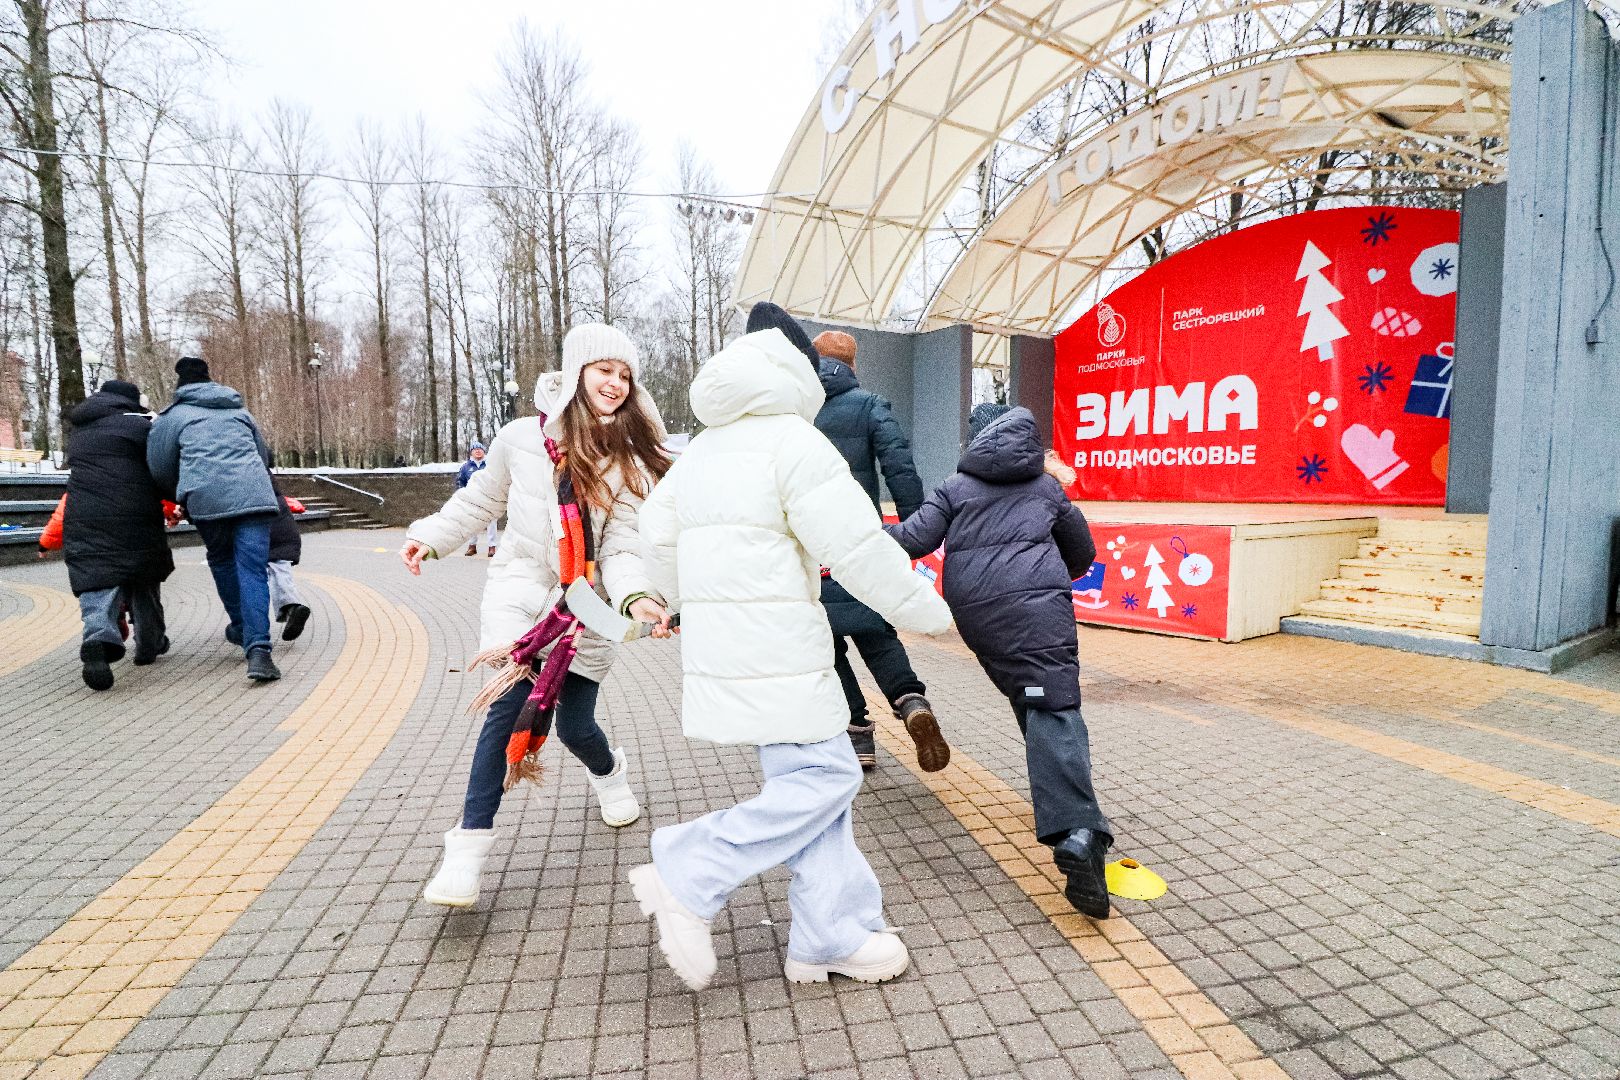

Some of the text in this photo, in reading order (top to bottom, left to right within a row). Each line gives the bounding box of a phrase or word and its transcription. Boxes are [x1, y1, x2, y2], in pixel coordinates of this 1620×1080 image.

[821, 65, 860, 134] С
[1047, 59, 1292, 207] ГОДОМ!
[1172, 304, 1265, 331] СЕСТРОРЕЦКИЙ
[1173, 306, 1204, 321] ПАРК
[1077, 355, 1146, 374] ПОДМОСКОВЬЯ
[1096, 349, 1126, 362] ПАРКИ
[1075, 374, 1259, 441] ЗИМА
[1090, 445, 1257, 469] ПОДМОСКОВЬЕ
